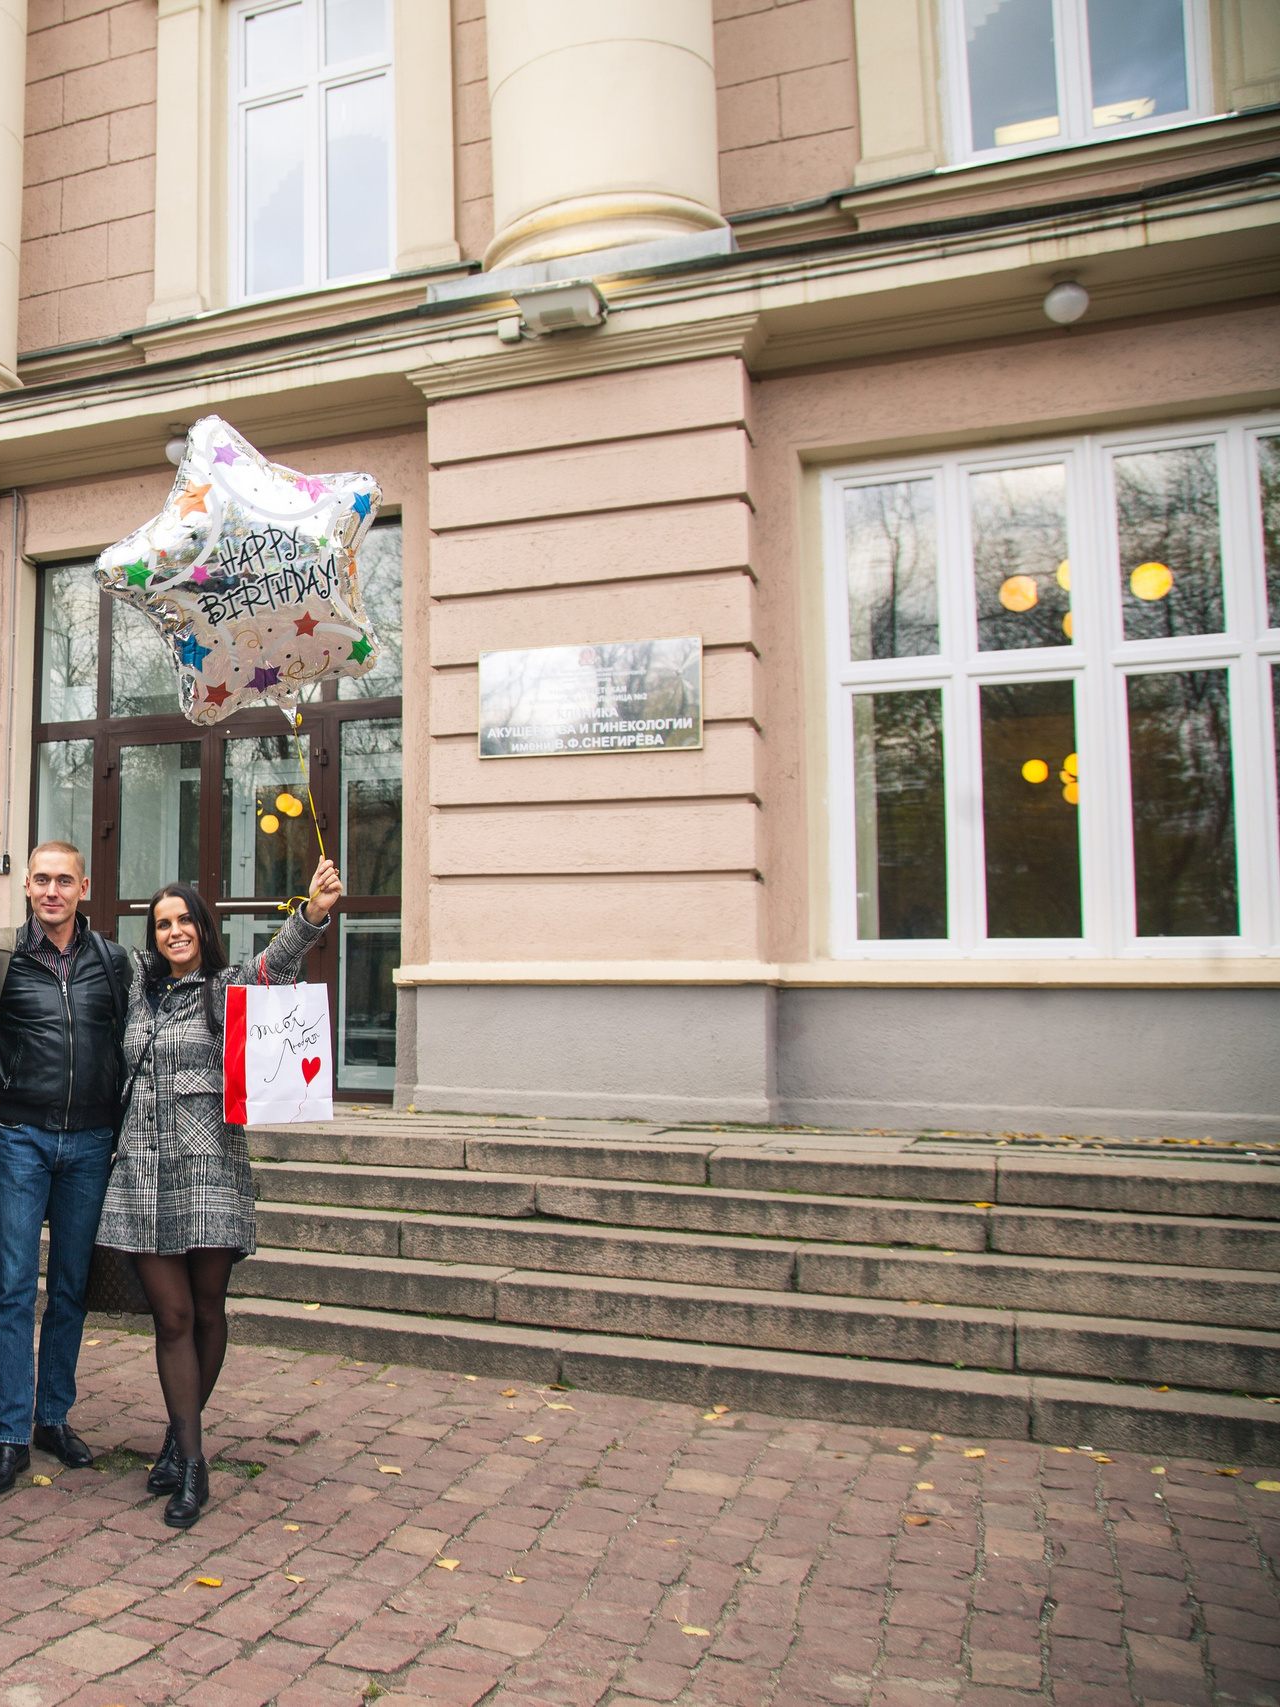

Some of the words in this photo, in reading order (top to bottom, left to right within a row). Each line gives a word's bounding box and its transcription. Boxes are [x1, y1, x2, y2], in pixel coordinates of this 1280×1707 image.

[218, 524, 301, 577] HAPPY
[198, 554, 340, 627] BIRTHDAY!
[557, 707, 620, 720] КЛИНИКА
[487, 723, 577, 739] АКУШЕРСТВА
[579, 721, 590, 734] И
[592, 717, 693, 734] ГИНЕКОЛОГИИ
[511, 740, 551, 752] имени
